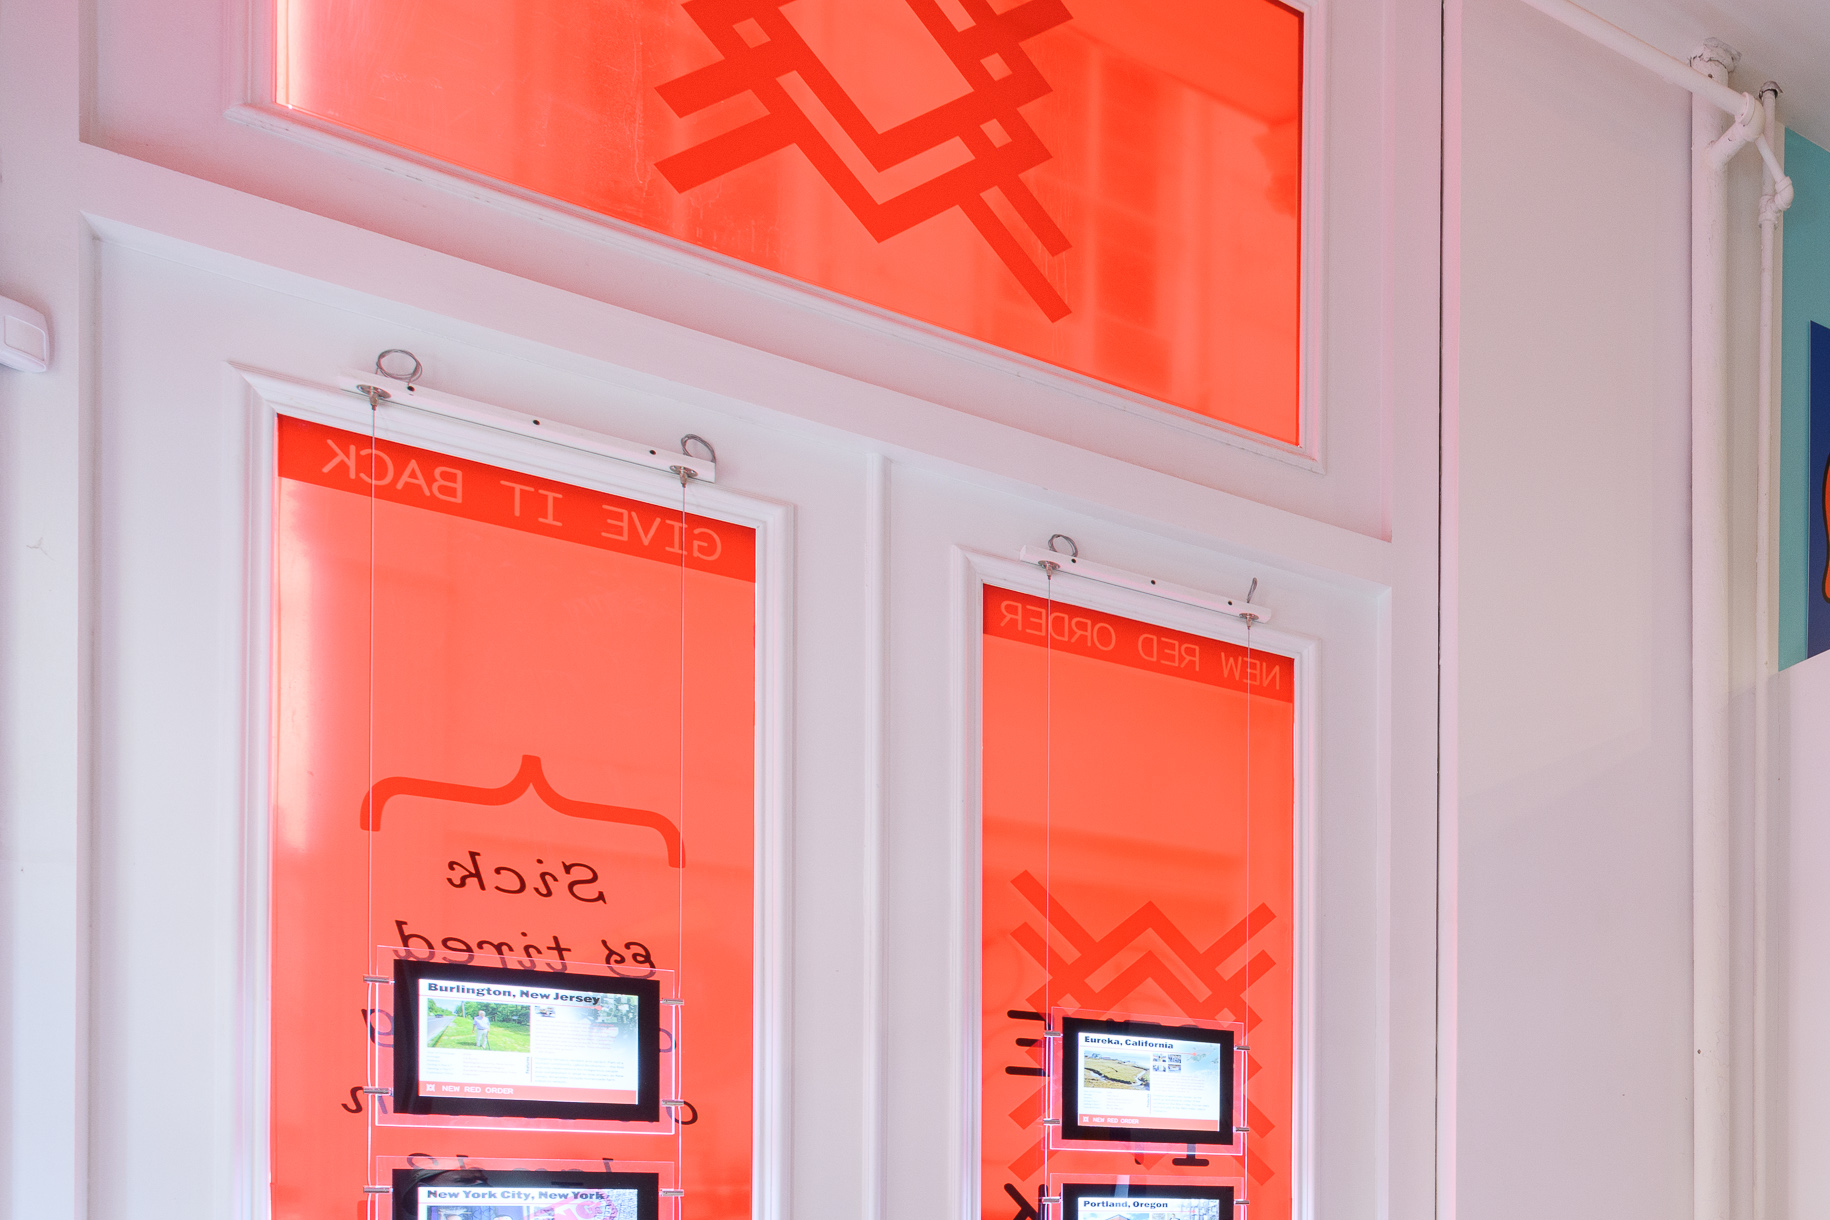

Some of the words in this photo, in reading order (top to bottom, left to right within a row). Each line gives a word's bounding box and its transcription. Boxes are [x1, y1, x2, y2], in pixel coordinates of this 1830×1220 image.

[427, 982, 516, 999] Burlington,
[519, 989, 551, 1000] New
[553, 991, 601, 1005] Jersey
[1084, 1035, 1123, 1046] Eureka,
[1125, 1039, 1174, 1049] California
[441, 1085, 460, 1093] NEW
[464, 1085, 482, 1093] RED
[485, 1086, 514, 1095] ORDER
[427, 1190, 460, 1199] New
[462, 1190, 498, 1199] York
[500, 1190, 535, 1201] City,
[538, 1191, 569, 1200] New
[1083, 1200, 1130, 1208] Portland,
[1132, 1201, 1168, 1209] Oregon
